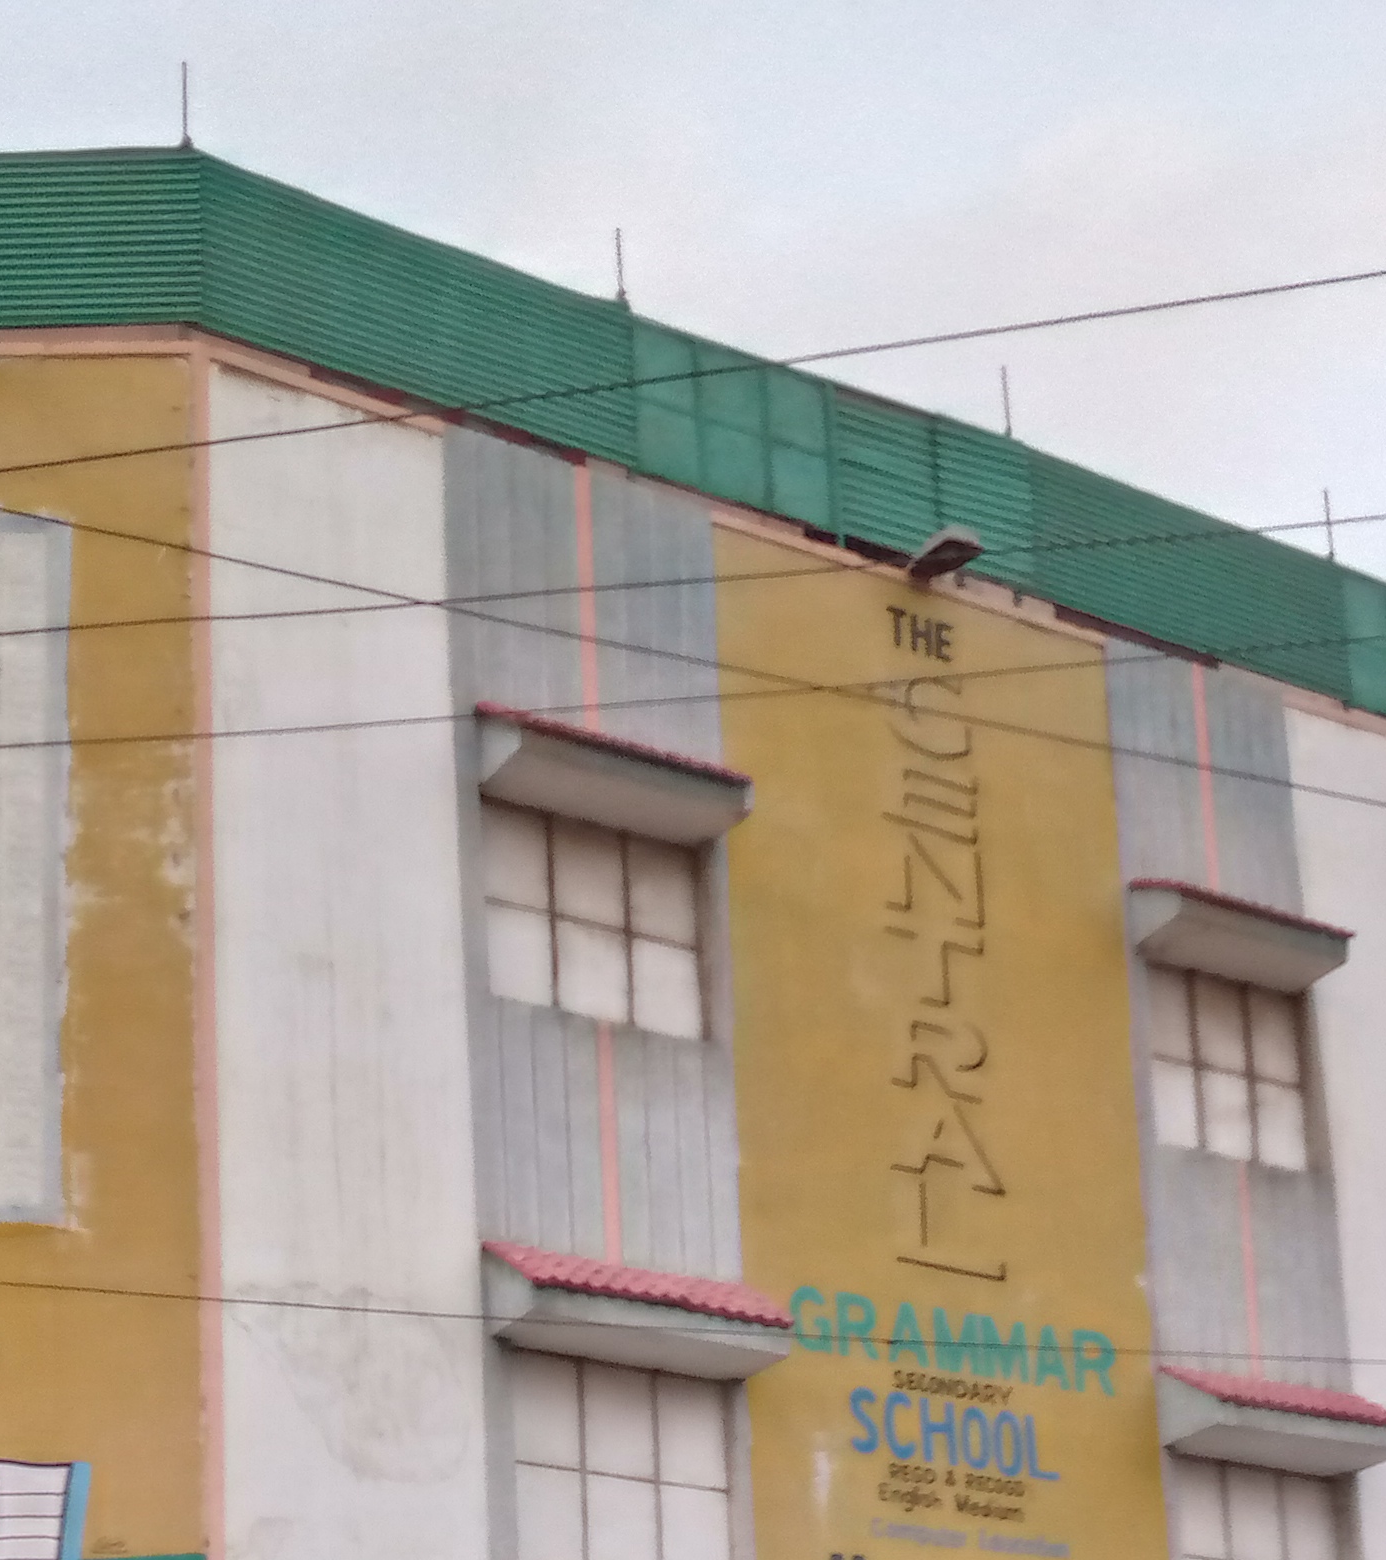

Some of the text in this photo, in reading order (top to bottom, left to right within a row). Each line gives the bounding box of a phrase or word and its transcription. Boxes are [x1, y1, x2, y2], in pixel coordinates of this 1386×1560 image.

[886, 604, 954, 663] THE
[789, 1286, 1116, 1396] GRAMMAR
[849, 1386, 1061, 1481] SCHOOL
